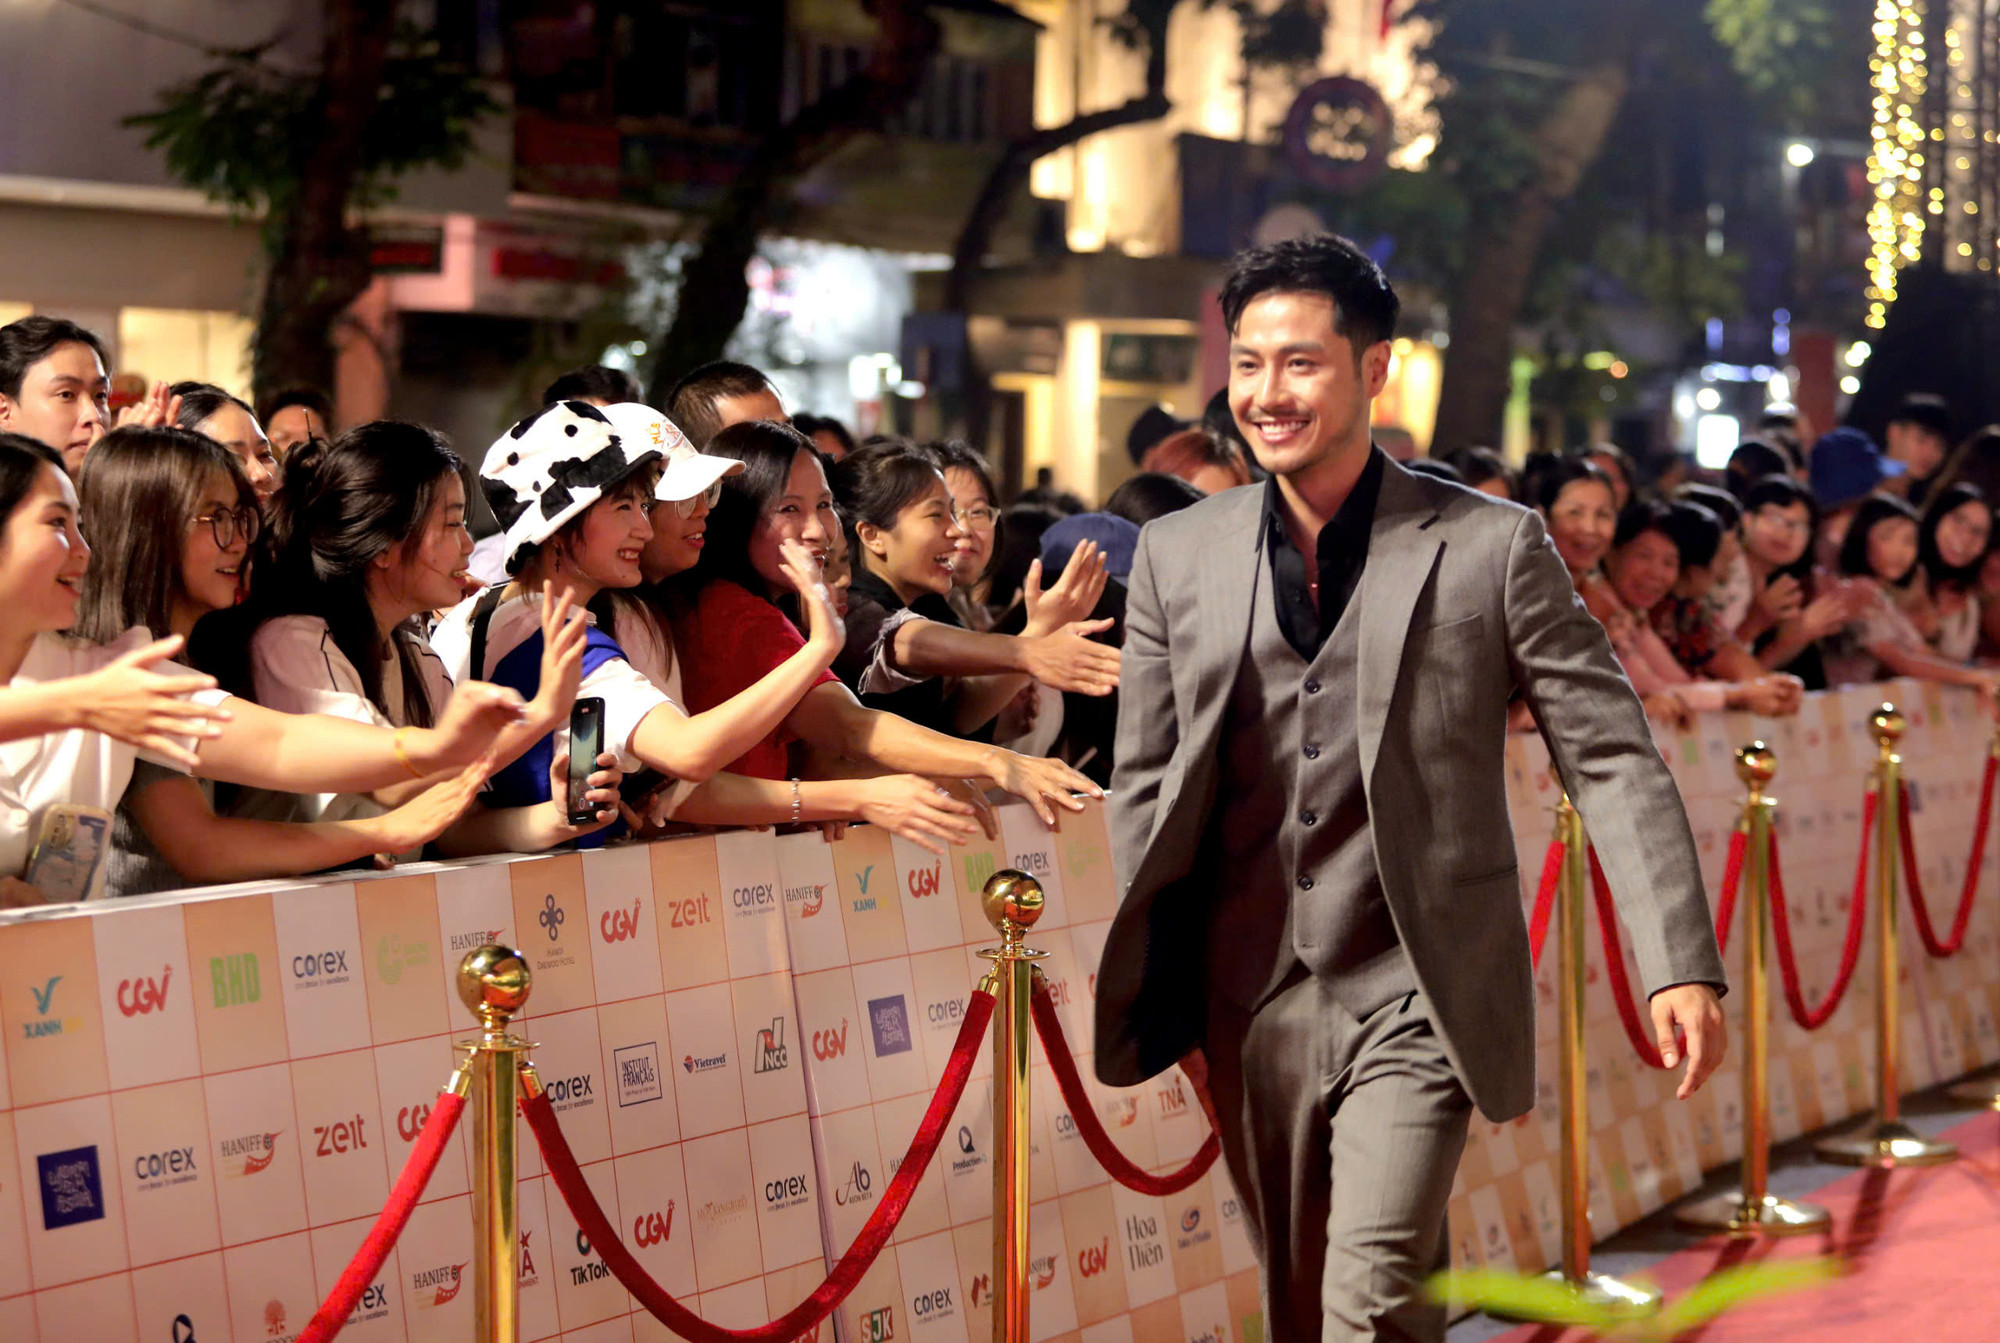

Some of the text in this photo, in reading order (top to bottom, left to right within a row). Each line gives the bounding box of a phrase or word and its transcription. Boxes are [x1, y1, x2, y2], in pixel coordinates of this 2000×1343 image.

[1015, 851, 1050, 871] corex
[733, 884, 775, 908] corex
[785, 886, 814, 902] HANIFF
[908, 865, 941, 899] CGV
[668, 892, 711, 929] zeit
[852, 898, 877, 913] XANH
[600, 905, 640, 944] CGV
[451, 930, 485, 950] HANIFF
[293, 950, 348, 978] corex
[117, 971, 171, 1017] CGV
[210, 952, 260, 1008] BHD
[1048, 978, 1071, 1007] eit
[928, 998, 966, 1022] corex
[22, 1019, 62, 1039] XANH
[812, 1022, 847, 1061] CGV
[622, 1057, 649, 1074] INSTITUT
[694, 1054, 727, 1069] Vietravel
[764, 1048, 788, 1070] NCC
[546, 1074, 593, 1103] corex
[1158, 1087, 1186, 1112] TNA
[314, 1113, 367, 1157] zeit
[397, 1103, 431, 1142] CG
[221, 1134, 262, 1157] HANIFF
[135, 1146, 197, 1179] corex
[765, 1174, 807, 1202] corex
[634, 1206, 673, 1249] CGV
[1126, 1214, 1157, 1241] Hoa
[1078, 1239, 1108, 1278] CGV
[413, 1266, 450, 1289] HANIFF
[570, 1260, 610, 1286] TikTok
[914, 1287, 952, 1316] corex
[861, 1308, 893, 1343] SJK
